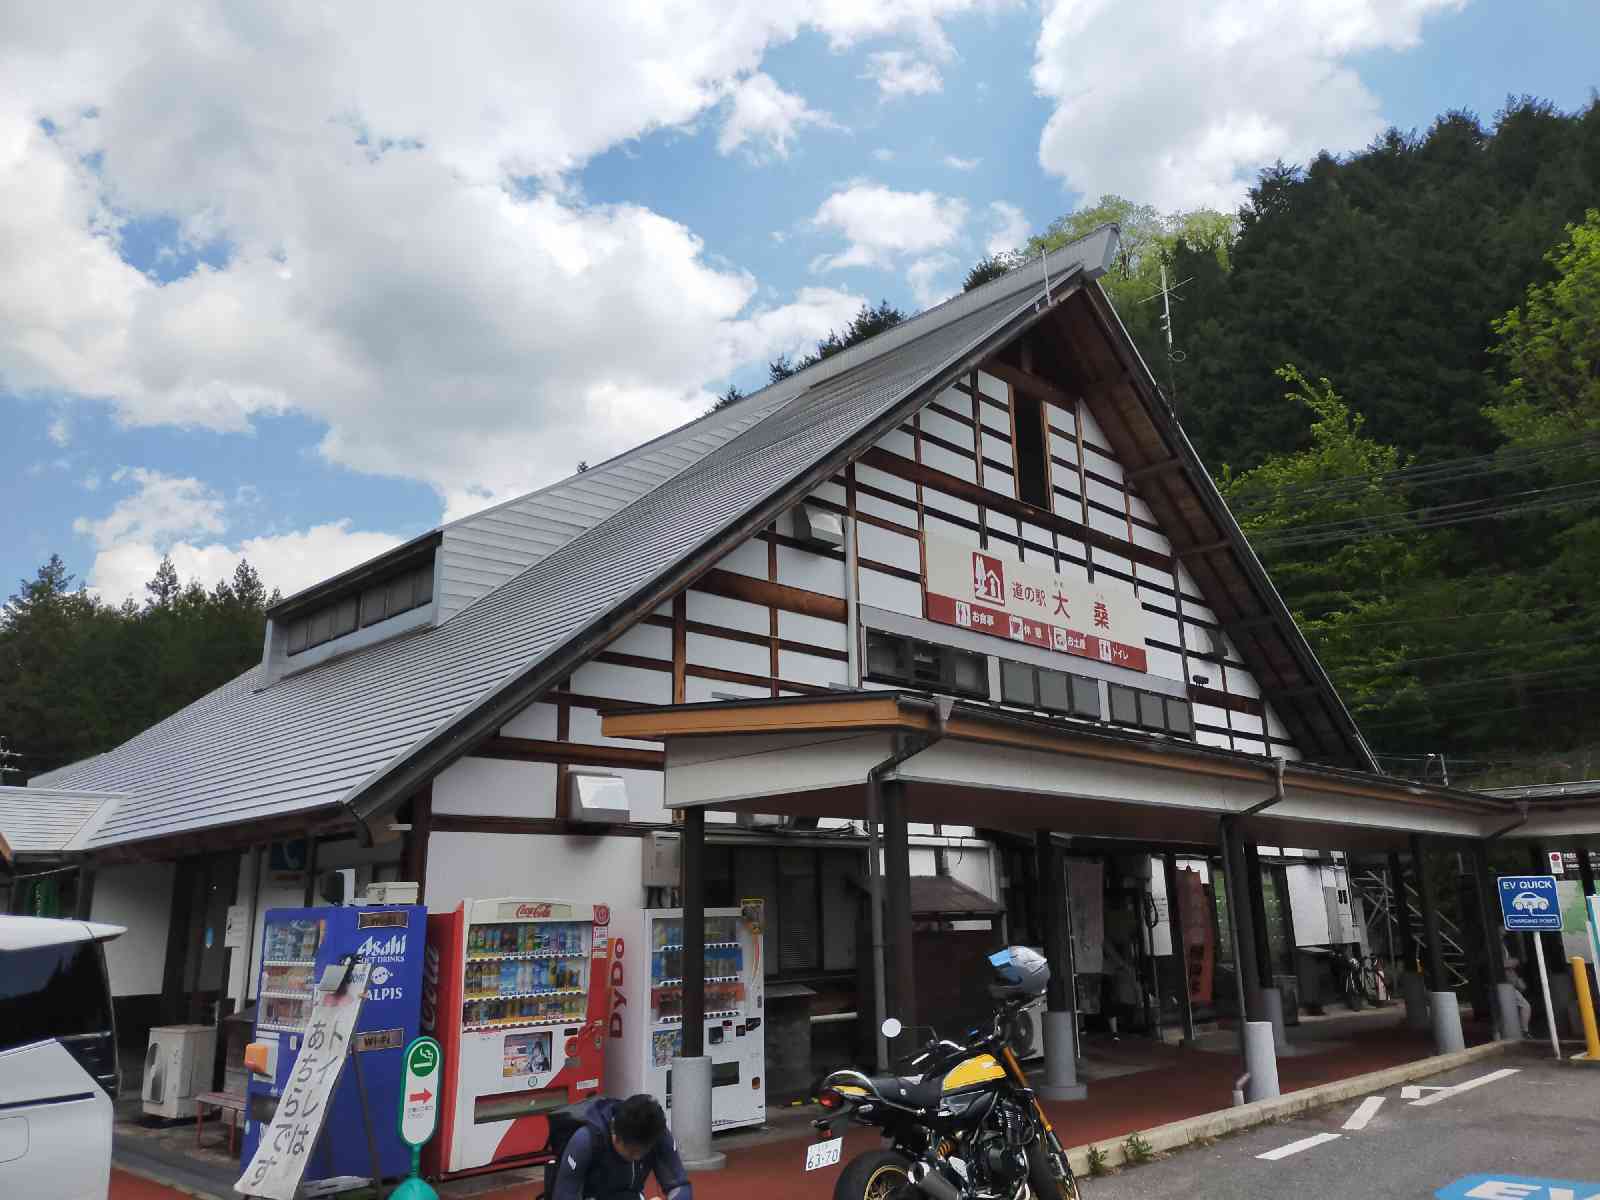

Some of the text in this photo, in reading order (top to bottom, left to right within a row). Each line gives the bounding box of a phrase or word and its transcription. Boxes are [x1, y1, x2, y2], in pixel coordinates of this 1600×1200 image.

[1012, 581, 1047, 608] 道の駅
[1519, 880, 1553, 889] QUICK
[515, 904, 551, 918] Coca-Cola
[356, 935, 407, 957] Asahi
[367, 986, 403, 1001] ALPIS
[807, 1150, 839, 1169] 63-70
